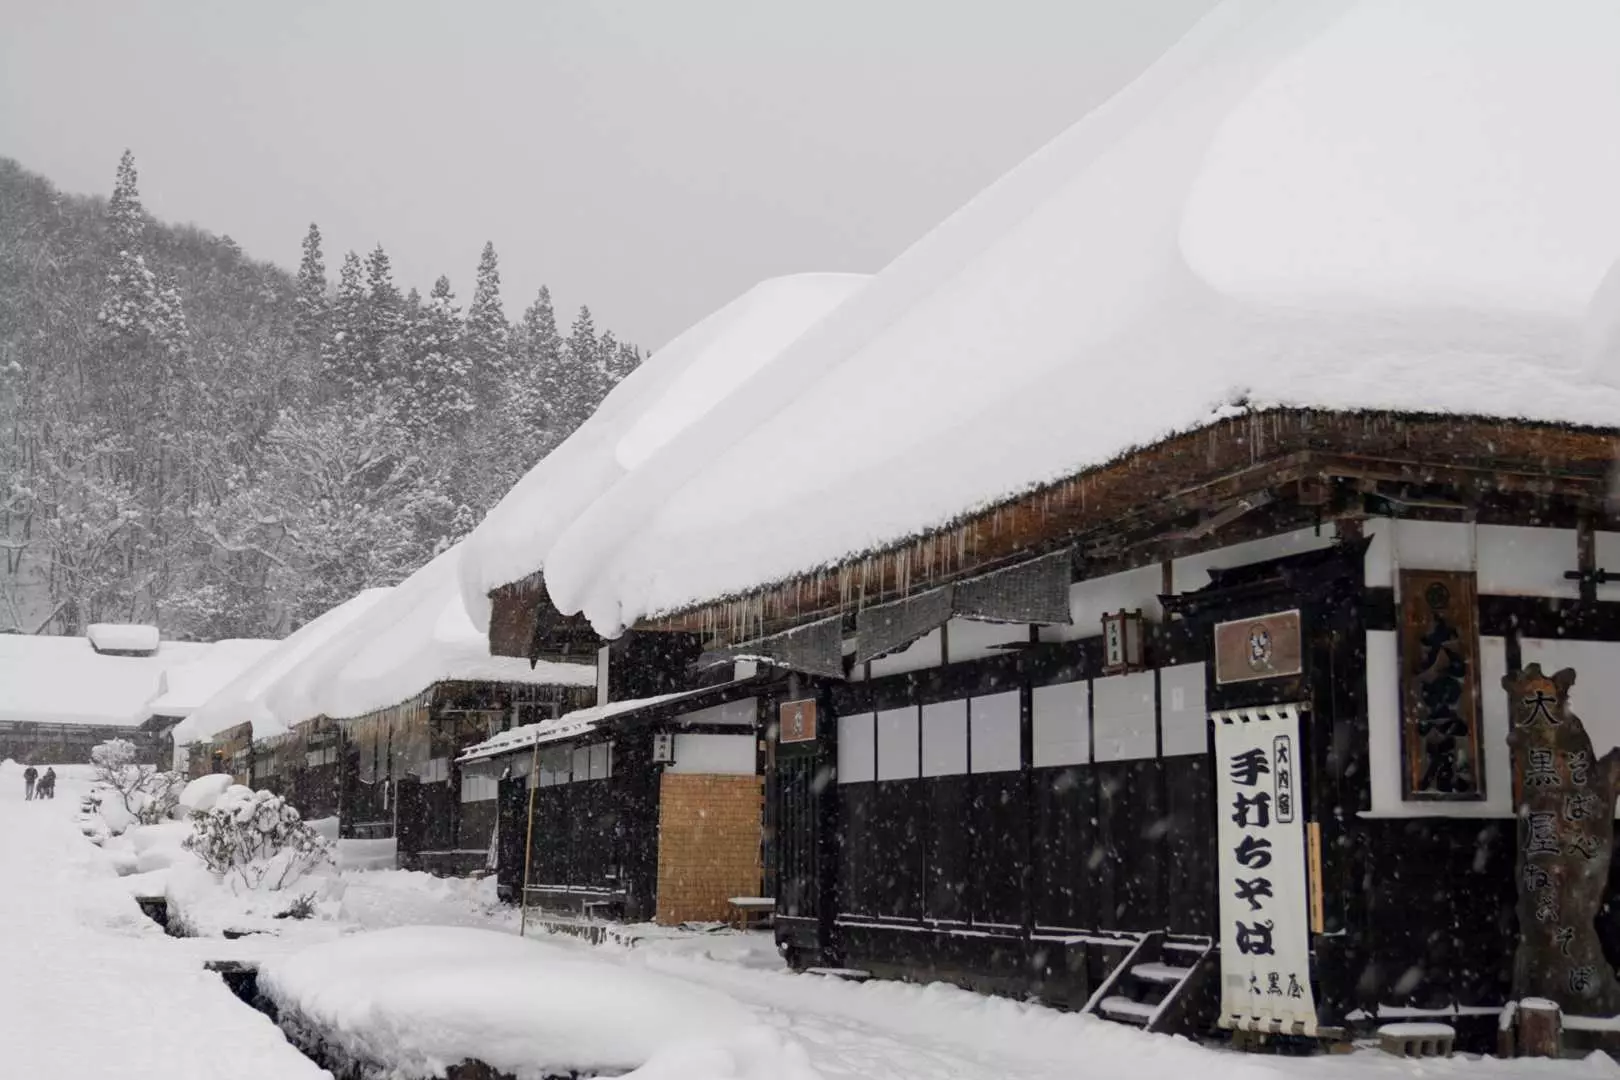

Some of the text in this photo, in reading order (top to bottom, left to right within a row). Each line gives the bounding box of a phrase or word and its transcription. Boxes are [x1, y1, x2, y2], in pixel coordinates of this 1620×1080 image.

[1277, 743, 1290, 815] 大内宿
[1521, 690, 1563, 855] 大黒屋
[1230, 748, 1275, 956] 手打ちそば
[1248, 972, 1305, 1000] 大黒屋
